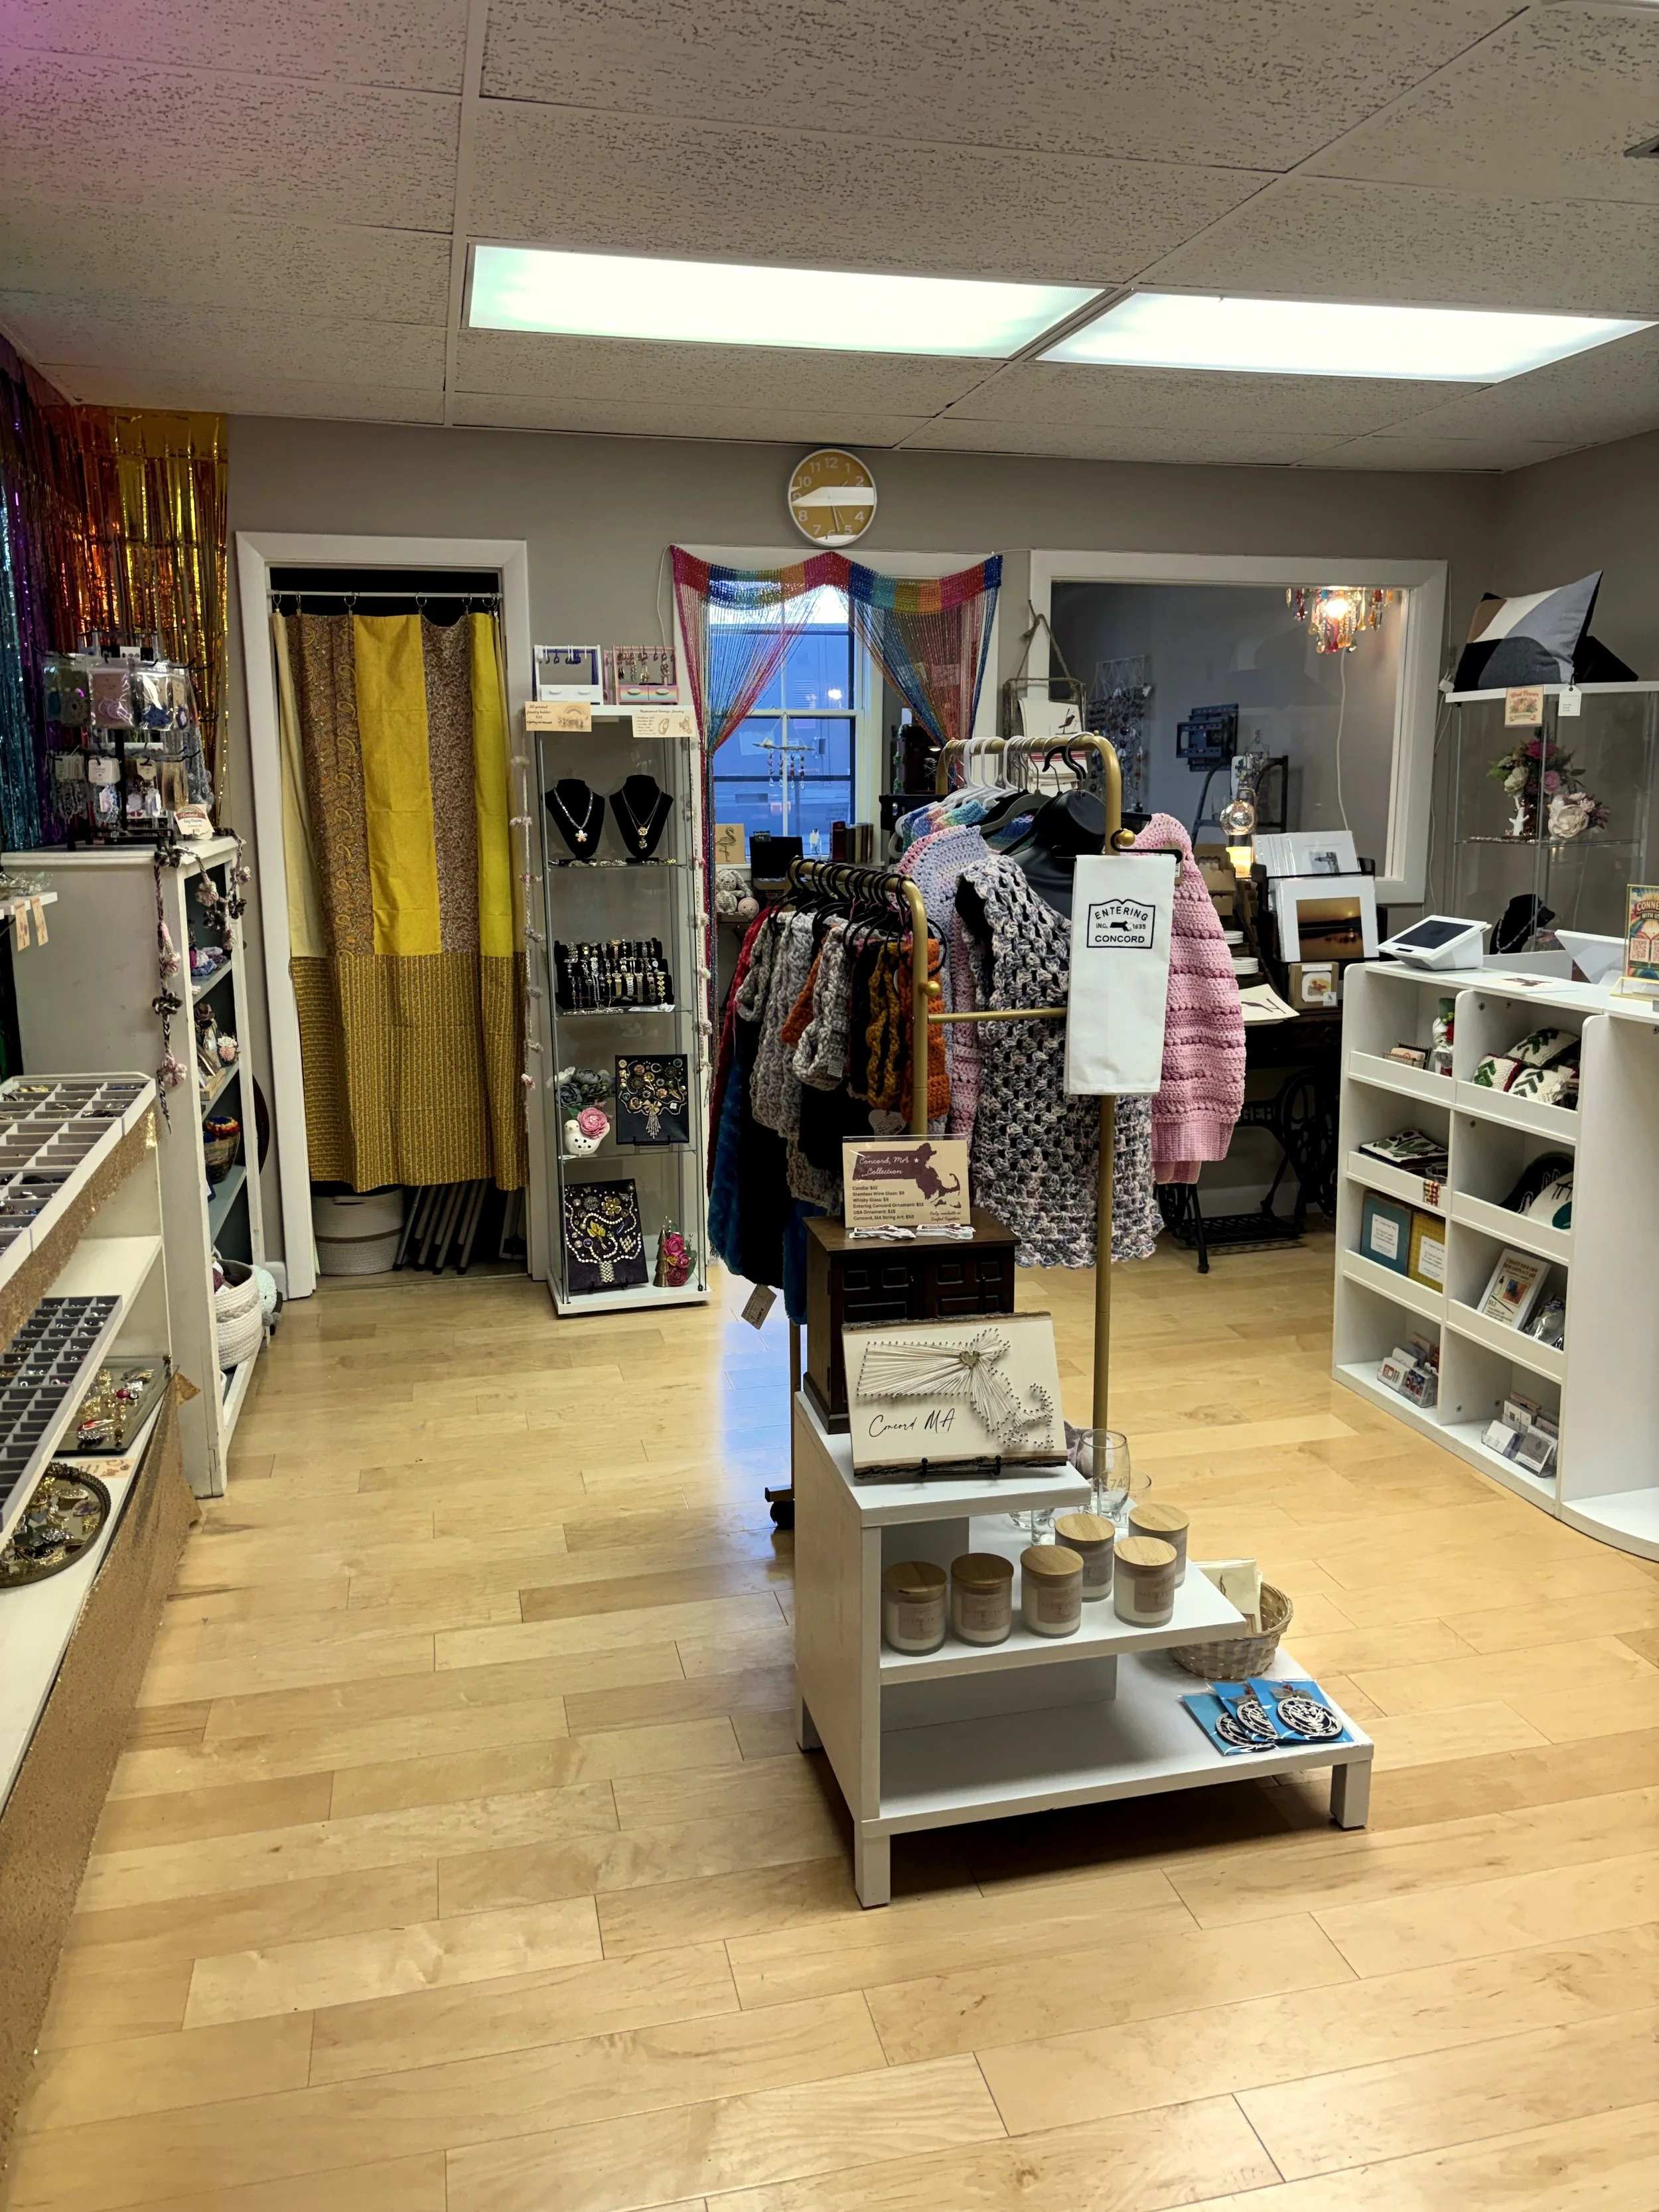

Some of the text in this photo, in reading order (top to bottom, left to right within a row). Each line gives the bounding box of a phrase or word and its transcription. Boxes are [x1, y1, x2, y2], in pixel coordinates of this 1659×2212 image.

[810, 462, 821, 473] 11
[824, 457, 838, 469] 12
[845, 463, 850, 473] 1
[798, 476, 812, 488] 10
[855, 476, 864, 486] 2
[798, 510, 808, 522] 8
[855, 511, 864, 522] 4
[813, 524, 822, 535] 7
[844, 525, 852, 535] 5
[1095, 907, 1148, 921] ENTERING
[859, 1156, 891, 1165] Concord,
[869, 1408, 956, 1437] Concord MA
